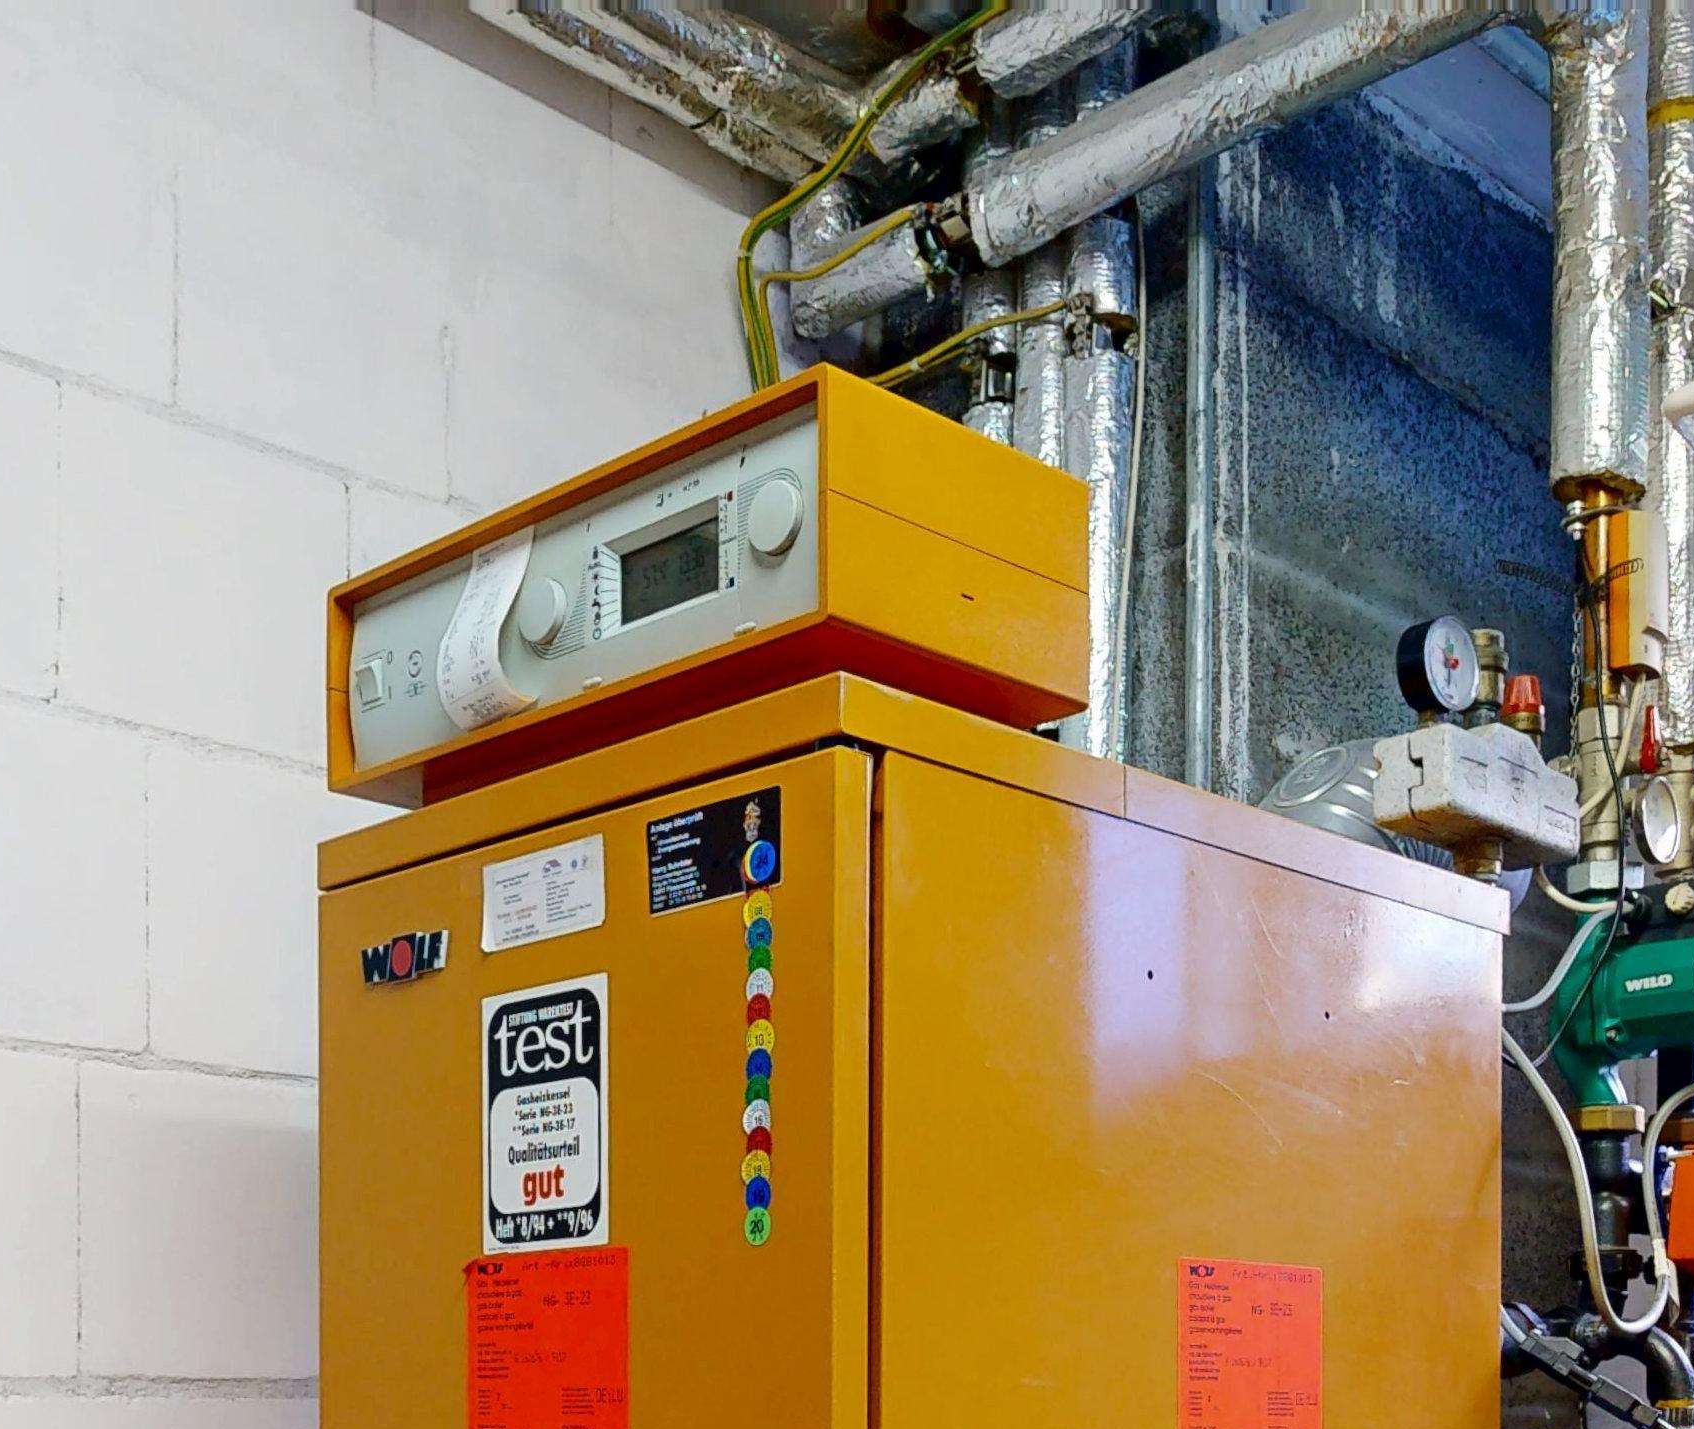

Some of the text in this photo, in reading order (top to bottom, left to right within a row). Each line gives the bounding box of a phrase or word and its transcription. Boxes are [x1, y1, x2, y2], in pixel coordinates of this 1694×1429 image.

[361, 930, 445, 984] WOLF
[1625, 973, 1674, 992] WILO
[494, 1000, 594, 1077] test
[516, 1087, 572, 1106] Gasheizkessel
[508, 1134, 580, 1165] Qualitätsurteil
[523, 1164, 564, 1206] gut
[496, 1216, 515, 1239] Heft
[750, 1219, 764, 1234] 20
